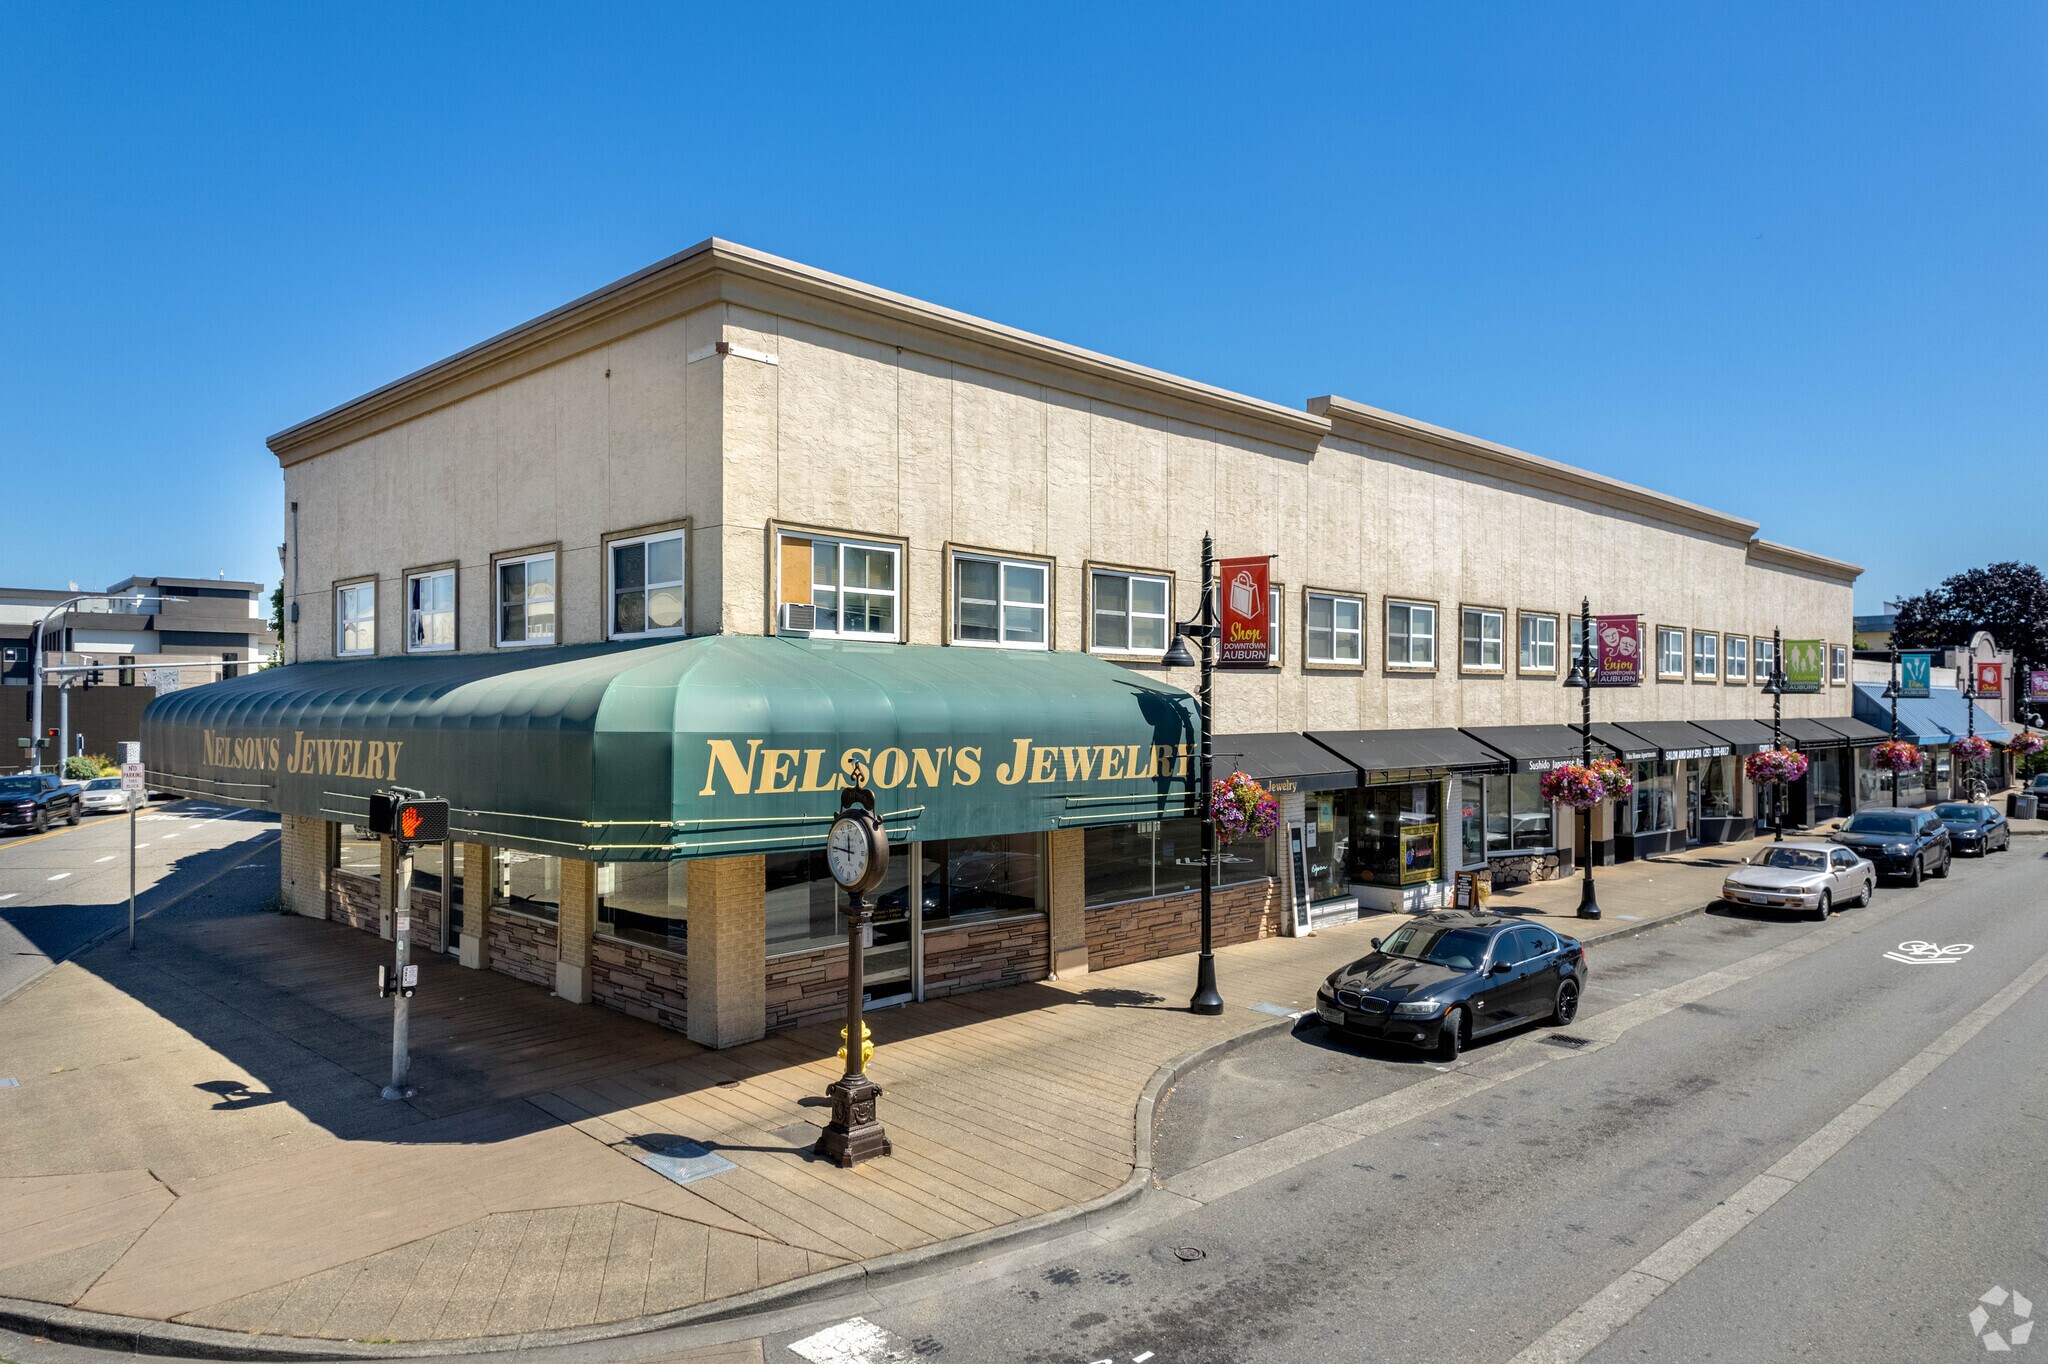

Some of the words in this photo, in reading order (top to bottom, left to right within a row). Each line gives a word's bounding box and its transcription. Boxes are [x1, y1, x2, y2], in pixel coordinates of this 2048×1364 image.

[1230, 622, 1262, 645] Shop
[1224, 642, 1266, 650] DOWNTOWN
[1223, 650, 1266, 659] AUBURN
[1604, 657, 1633, 671] Enjoy
[203, 729, 281, 772] NELSON'S
[287, 731, 403, 781] JEWELRY
[1686, 749, 1694, 759] DAY
[1694, 748, 1702, 758] SPA
[698, 739, 982, 796] NELSON'S
[996, 738, 1198, 786] JEWELRY
[1529, 759, 1551, 770] Sushido
[1268, 780, 1297, 792] Jewelry
[1311, 863, 1328, 877] Open
